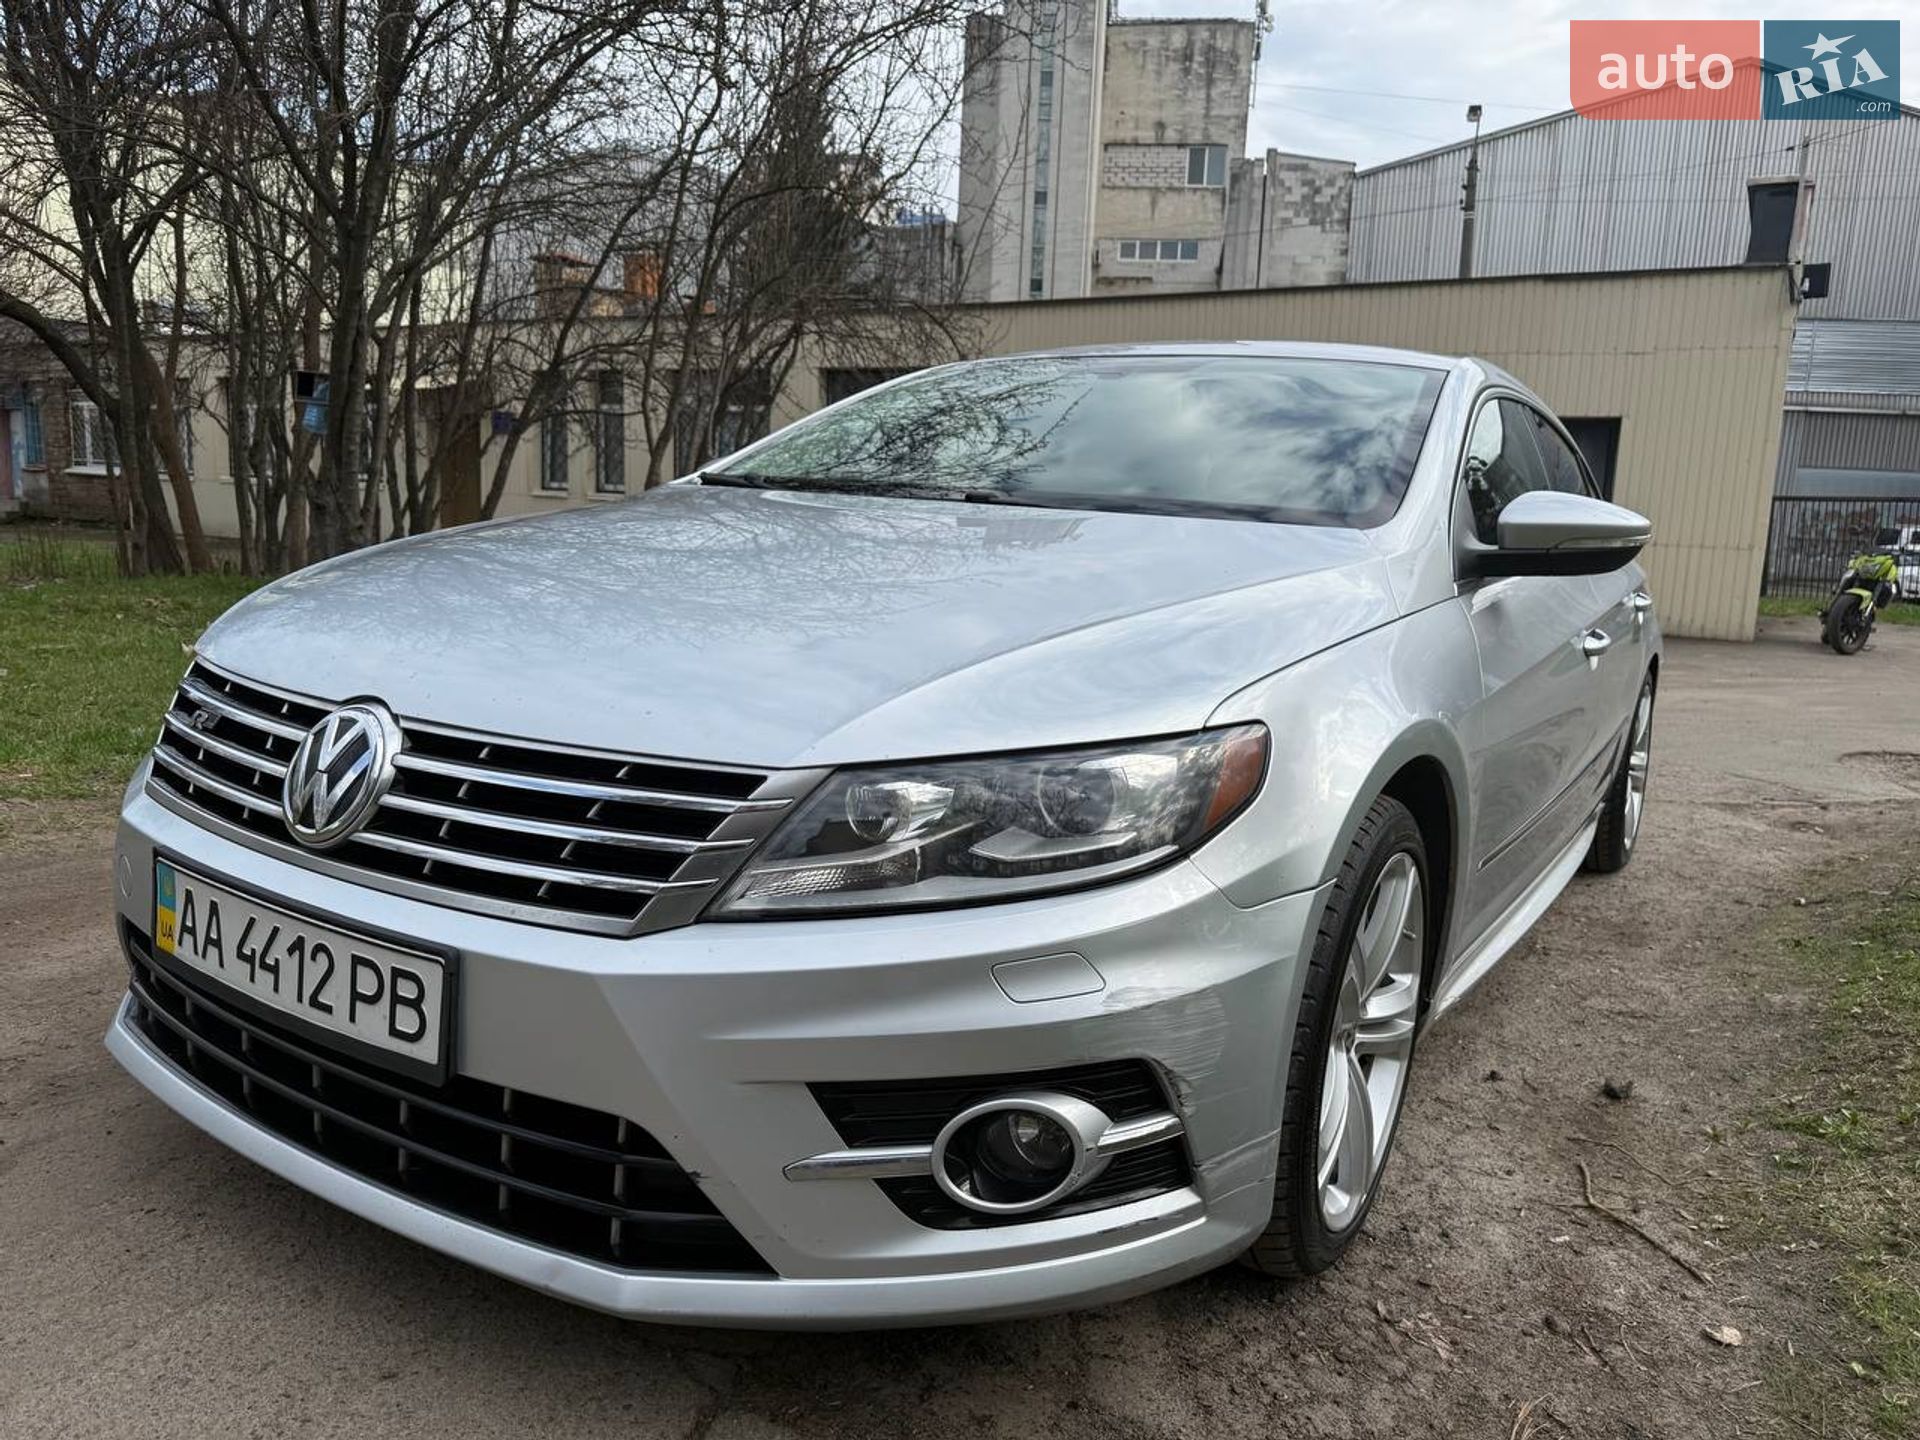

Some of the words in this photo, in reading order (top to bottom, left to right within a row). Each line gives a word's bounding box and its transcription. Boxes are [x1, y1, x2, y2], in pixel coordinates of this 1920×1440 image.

[160, 921, 175, 942] UA
[177, 887, 225, 969] AA
[235, 915, 335, 1016] 4412
[348, 950, 428, 1044] PB
